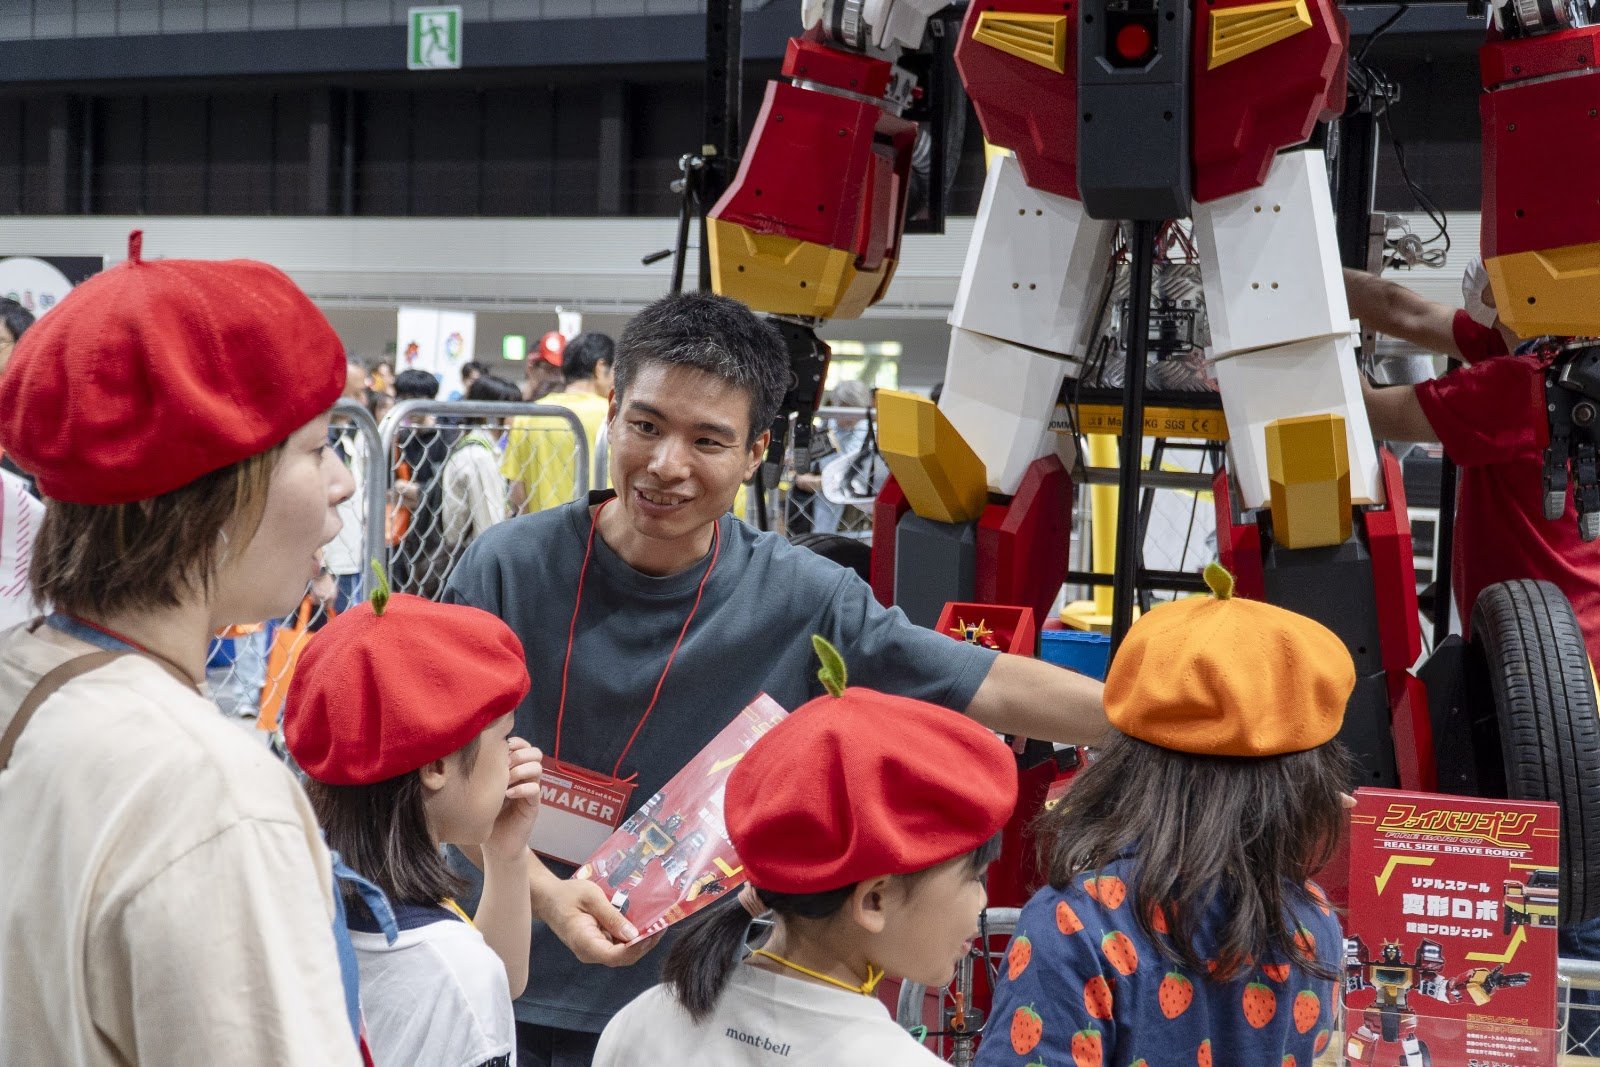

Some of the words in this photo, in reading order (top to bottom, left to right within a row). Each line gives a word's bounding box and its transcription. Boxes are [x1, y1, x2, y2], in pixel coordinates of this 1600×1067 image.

[540, 785, 615, 821] MAKER
[1381, 803, 1537, 841] ファイバリオン
[1384, 841, 1413, 850] REAL
[1444, 846, 1483, 855] BRAVE
[1484, 848, 1527, 858] ROBOT
[1411, 877, 1491, 893] リアルスケール
[1402, 893, 1499, 922] 変形ロボ
